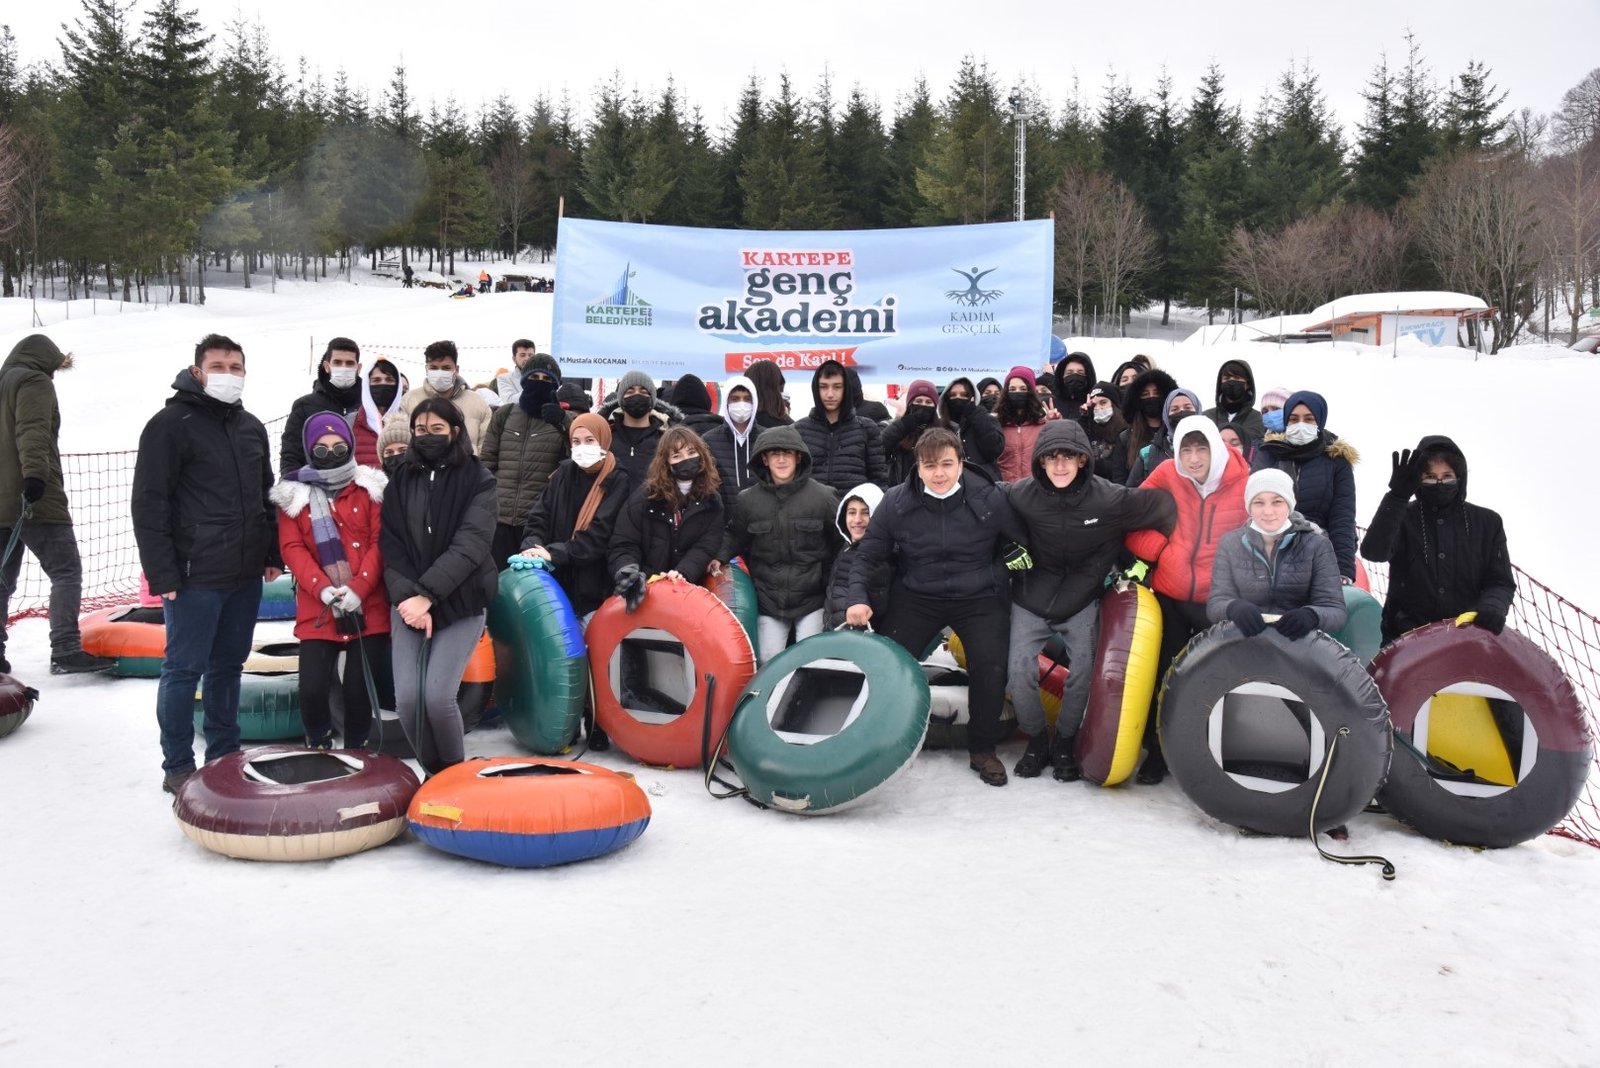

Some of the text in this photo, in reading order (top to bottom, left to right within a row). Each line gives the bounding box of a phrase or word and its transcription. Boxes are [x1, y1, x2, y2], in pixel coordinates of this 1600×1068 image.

[742, 252, 851, 266] KARTEPE
[745, 268, 853, 307] genç
[586, 305, 647, 316] KARTEPE
[699, 297, 897, 334] akademi
[950, 310, 994, 322] KADİM
[585, 315, 648, 326] BELEDİYESİ
[942, 322, 1001, 336] GENÇLİK
[593, 357, 627, 365] KOCAMAN
[776, 354, 795, 368] de
